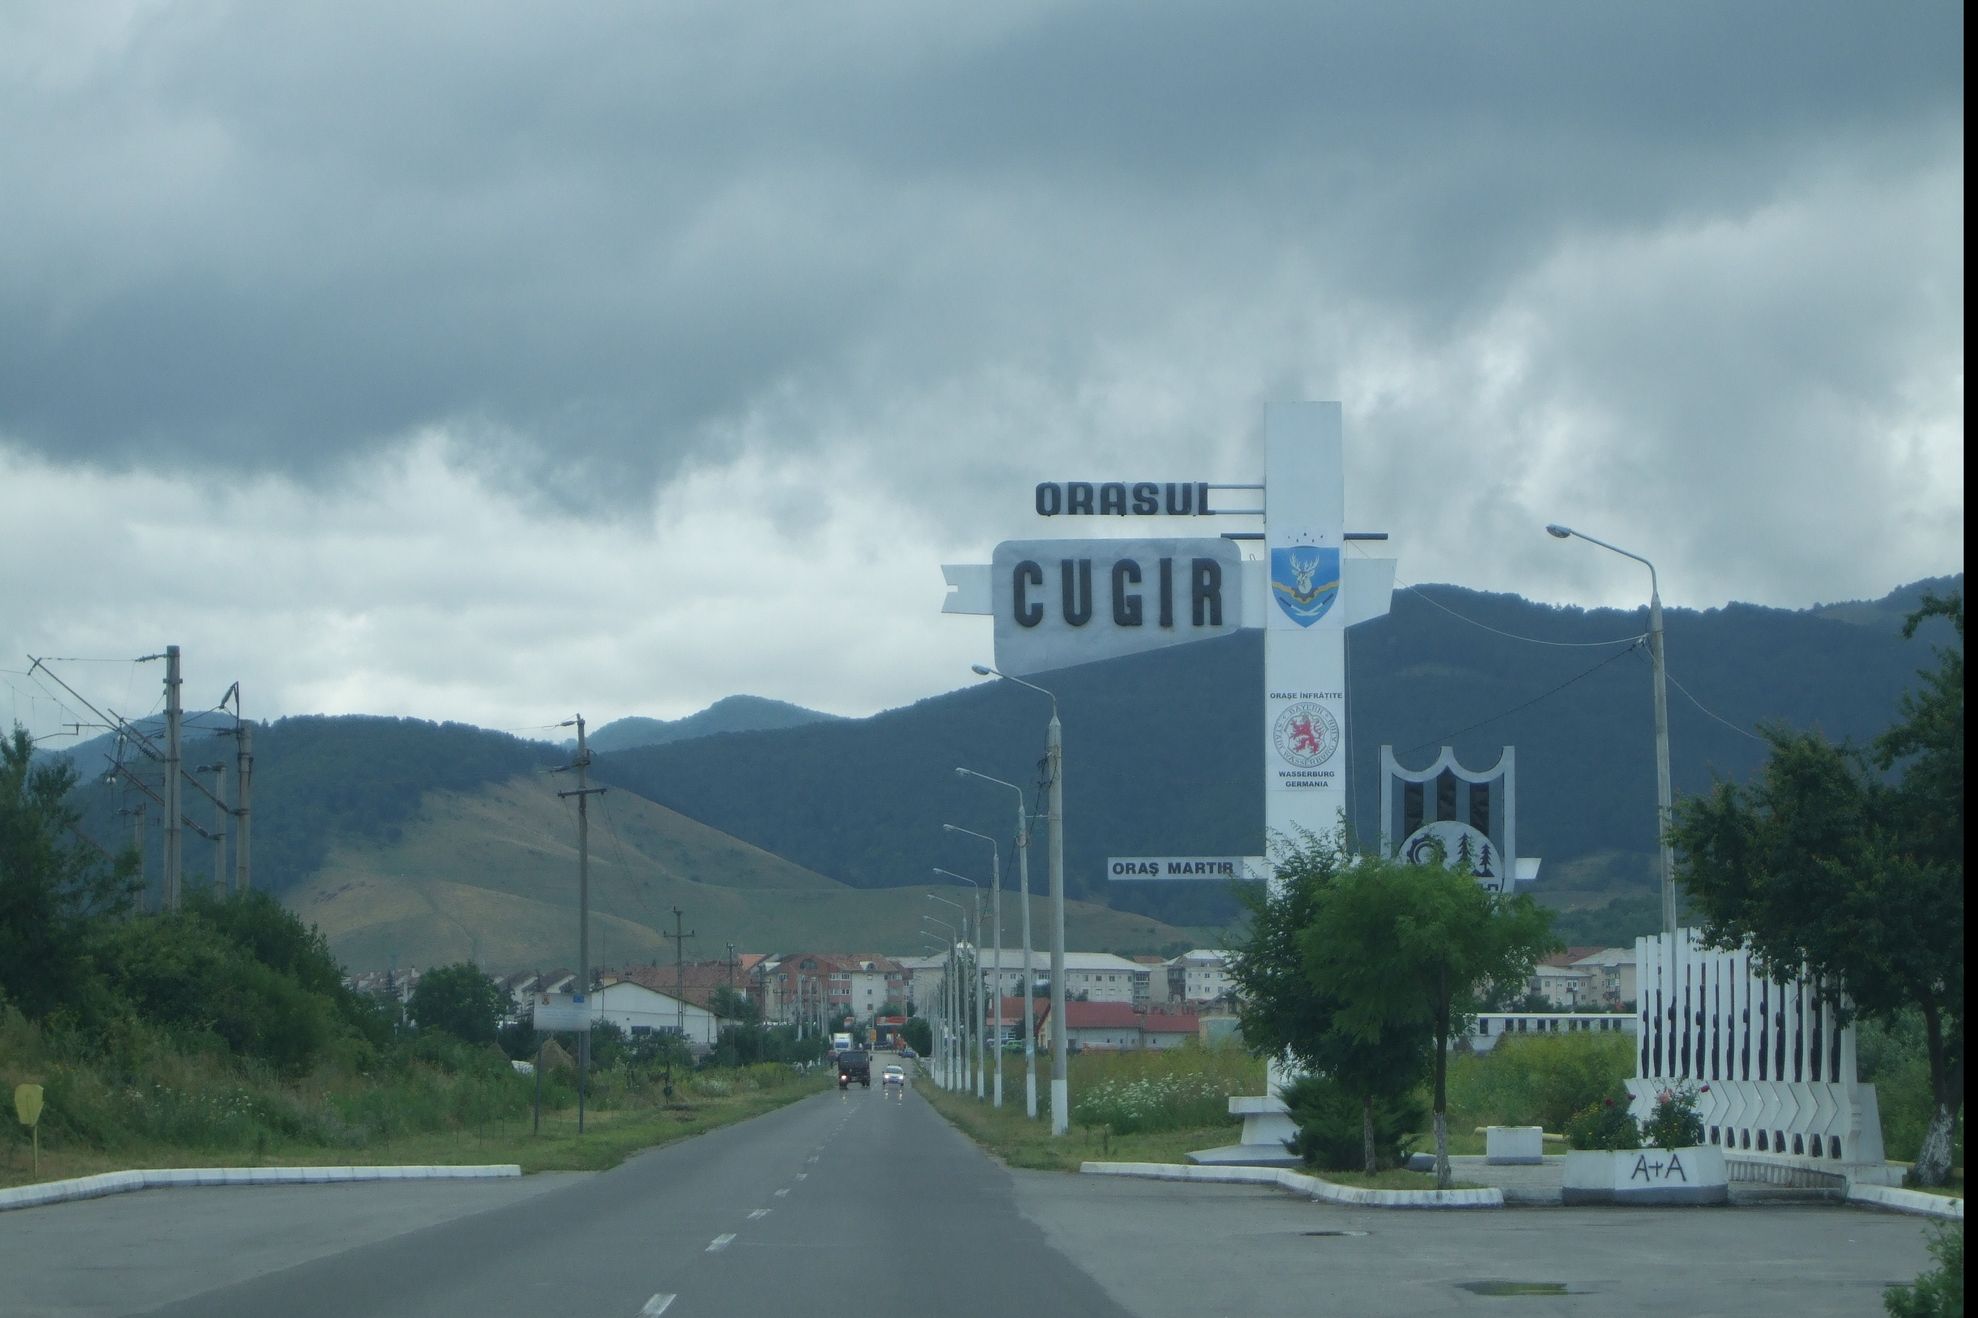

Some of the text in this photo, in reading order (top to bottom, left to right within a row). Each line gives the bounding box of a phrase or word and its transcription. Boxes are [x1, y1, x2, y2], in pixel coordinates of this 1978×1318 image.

[1035, 482, 1216, 516] ORASUL
[1013, 557, 1222, 627] CUGIR
[1167, 862, 1233, 875] MARTIR
[1631, 1153, 1687, 1182] A+A
